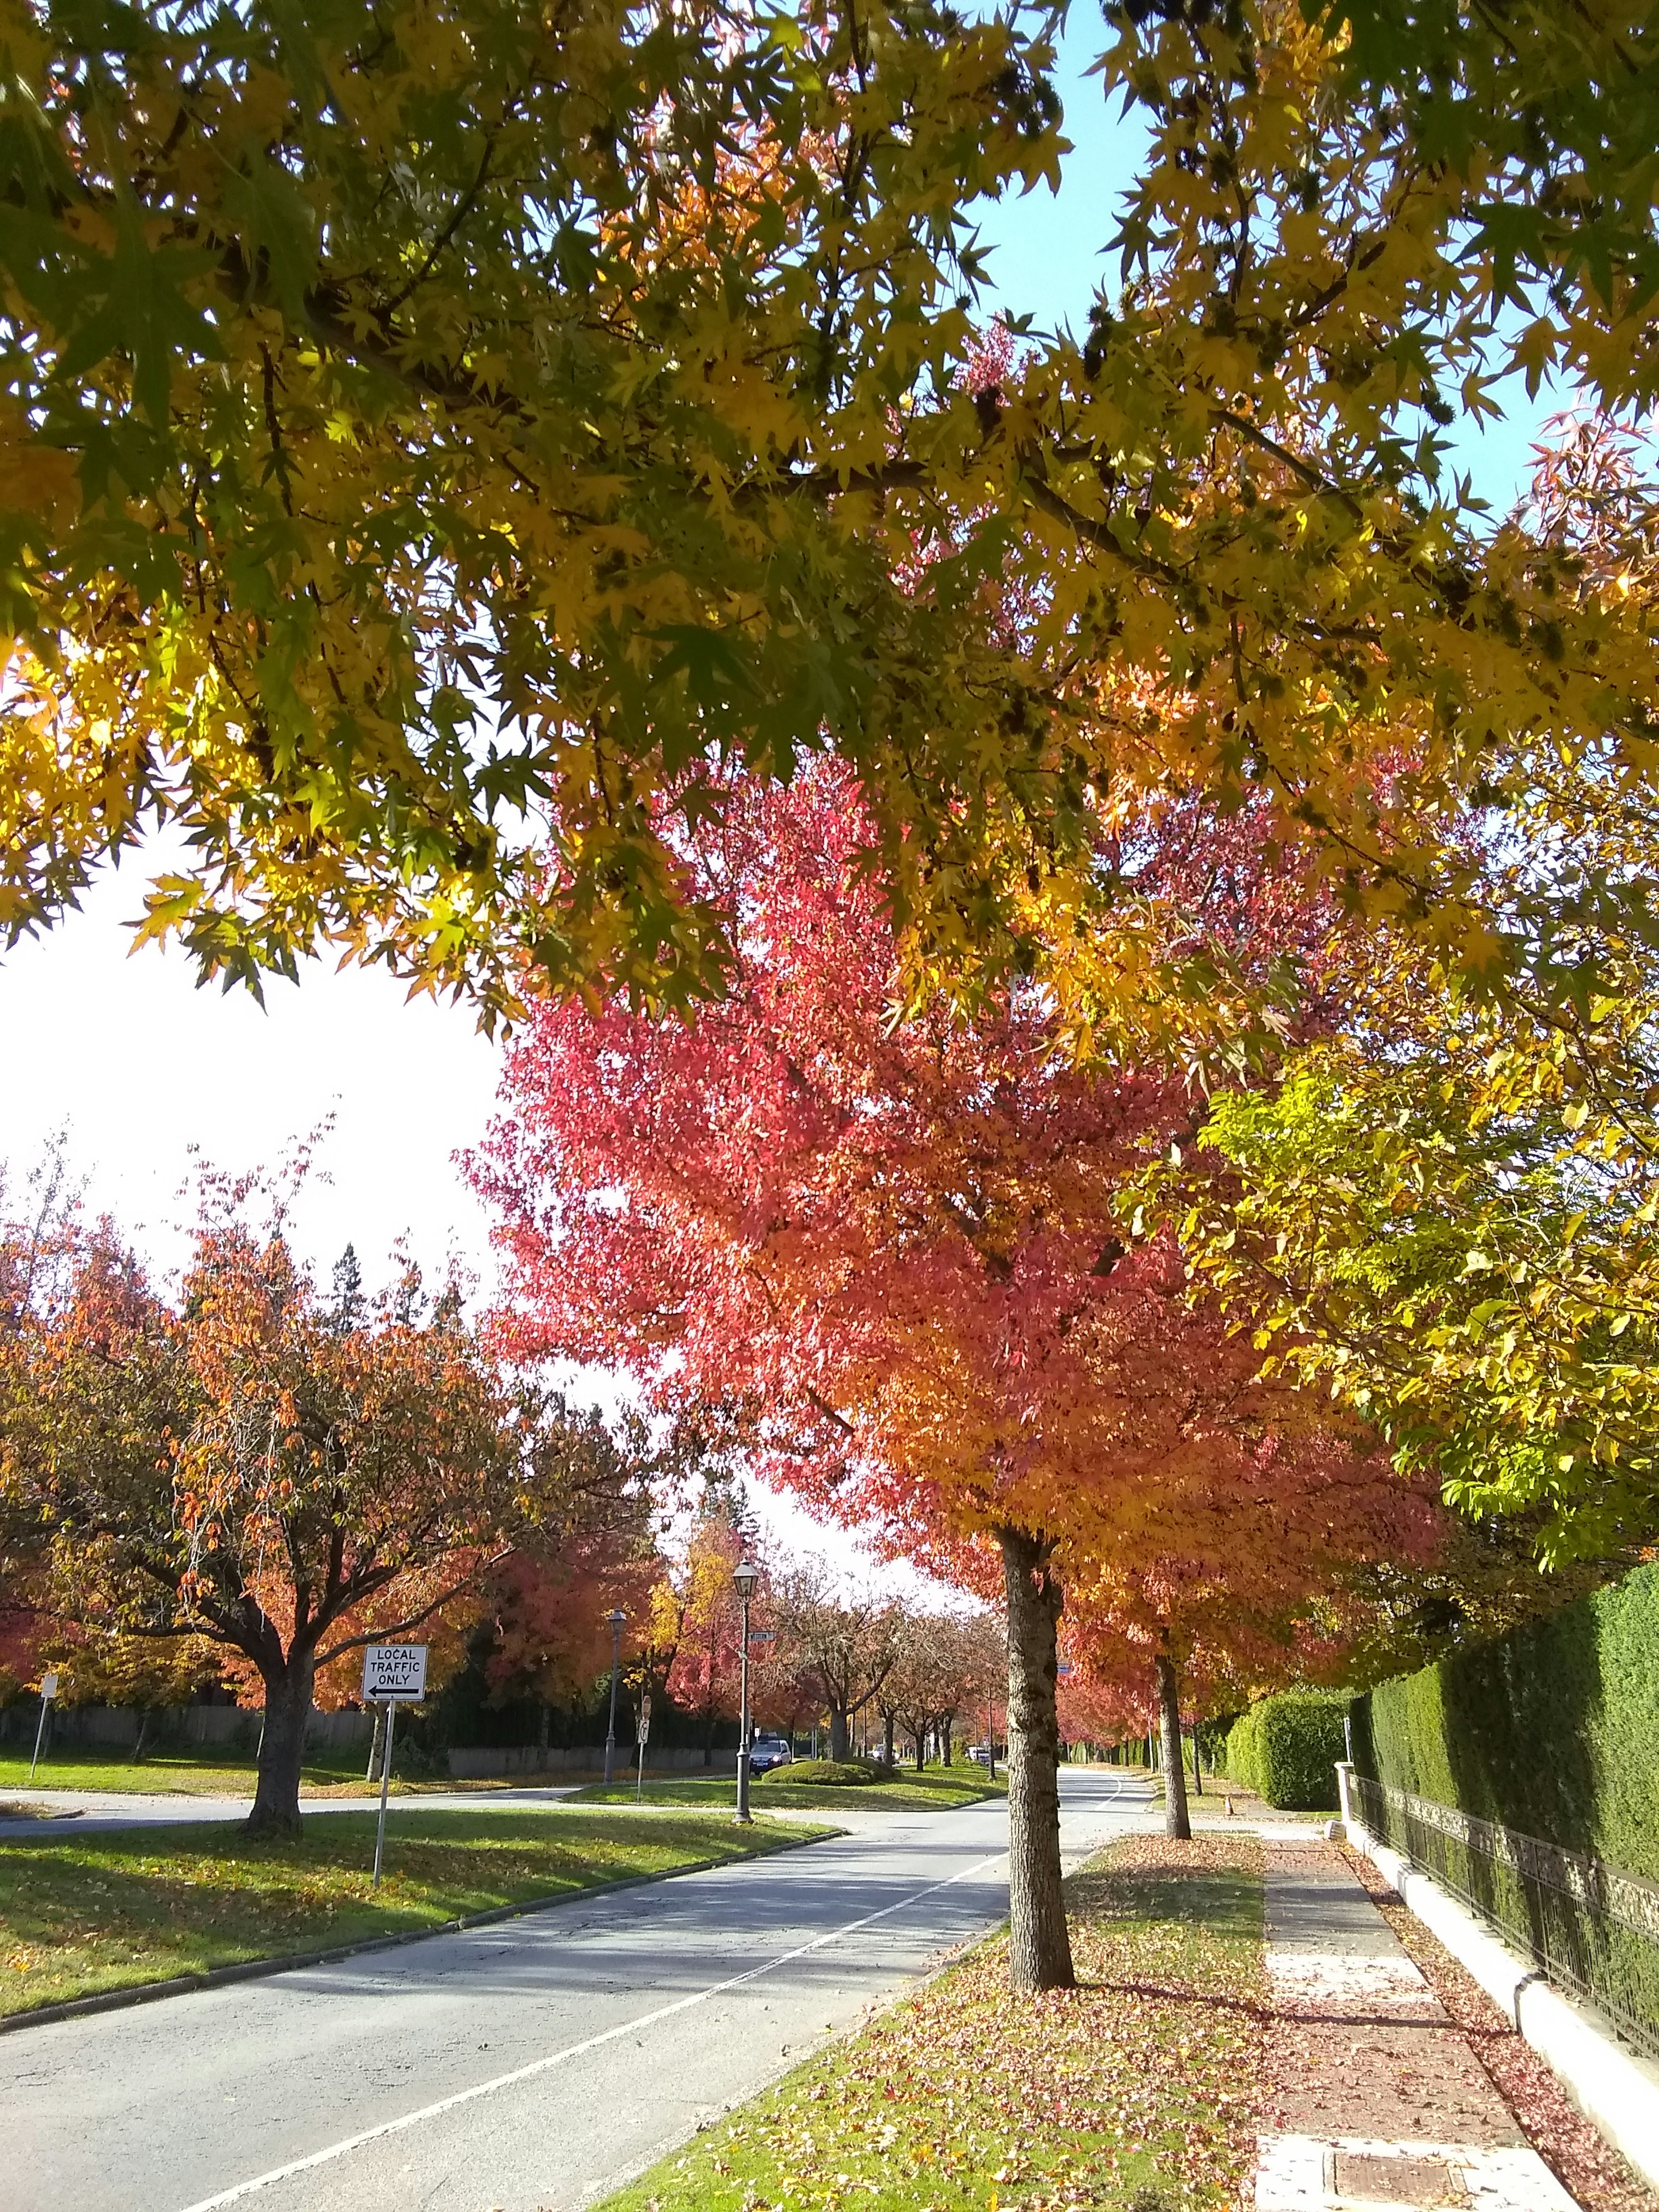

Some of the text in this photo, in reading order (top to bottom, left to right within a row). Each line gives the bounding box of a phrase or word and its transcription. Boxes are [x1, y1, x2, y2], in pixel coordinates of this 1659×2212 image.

[378, 1650, 416, 1659] LOCAL
[371, 1662, 420, 1672] TRAFFIC
[378, 1675, 410, 1684] ONLY
